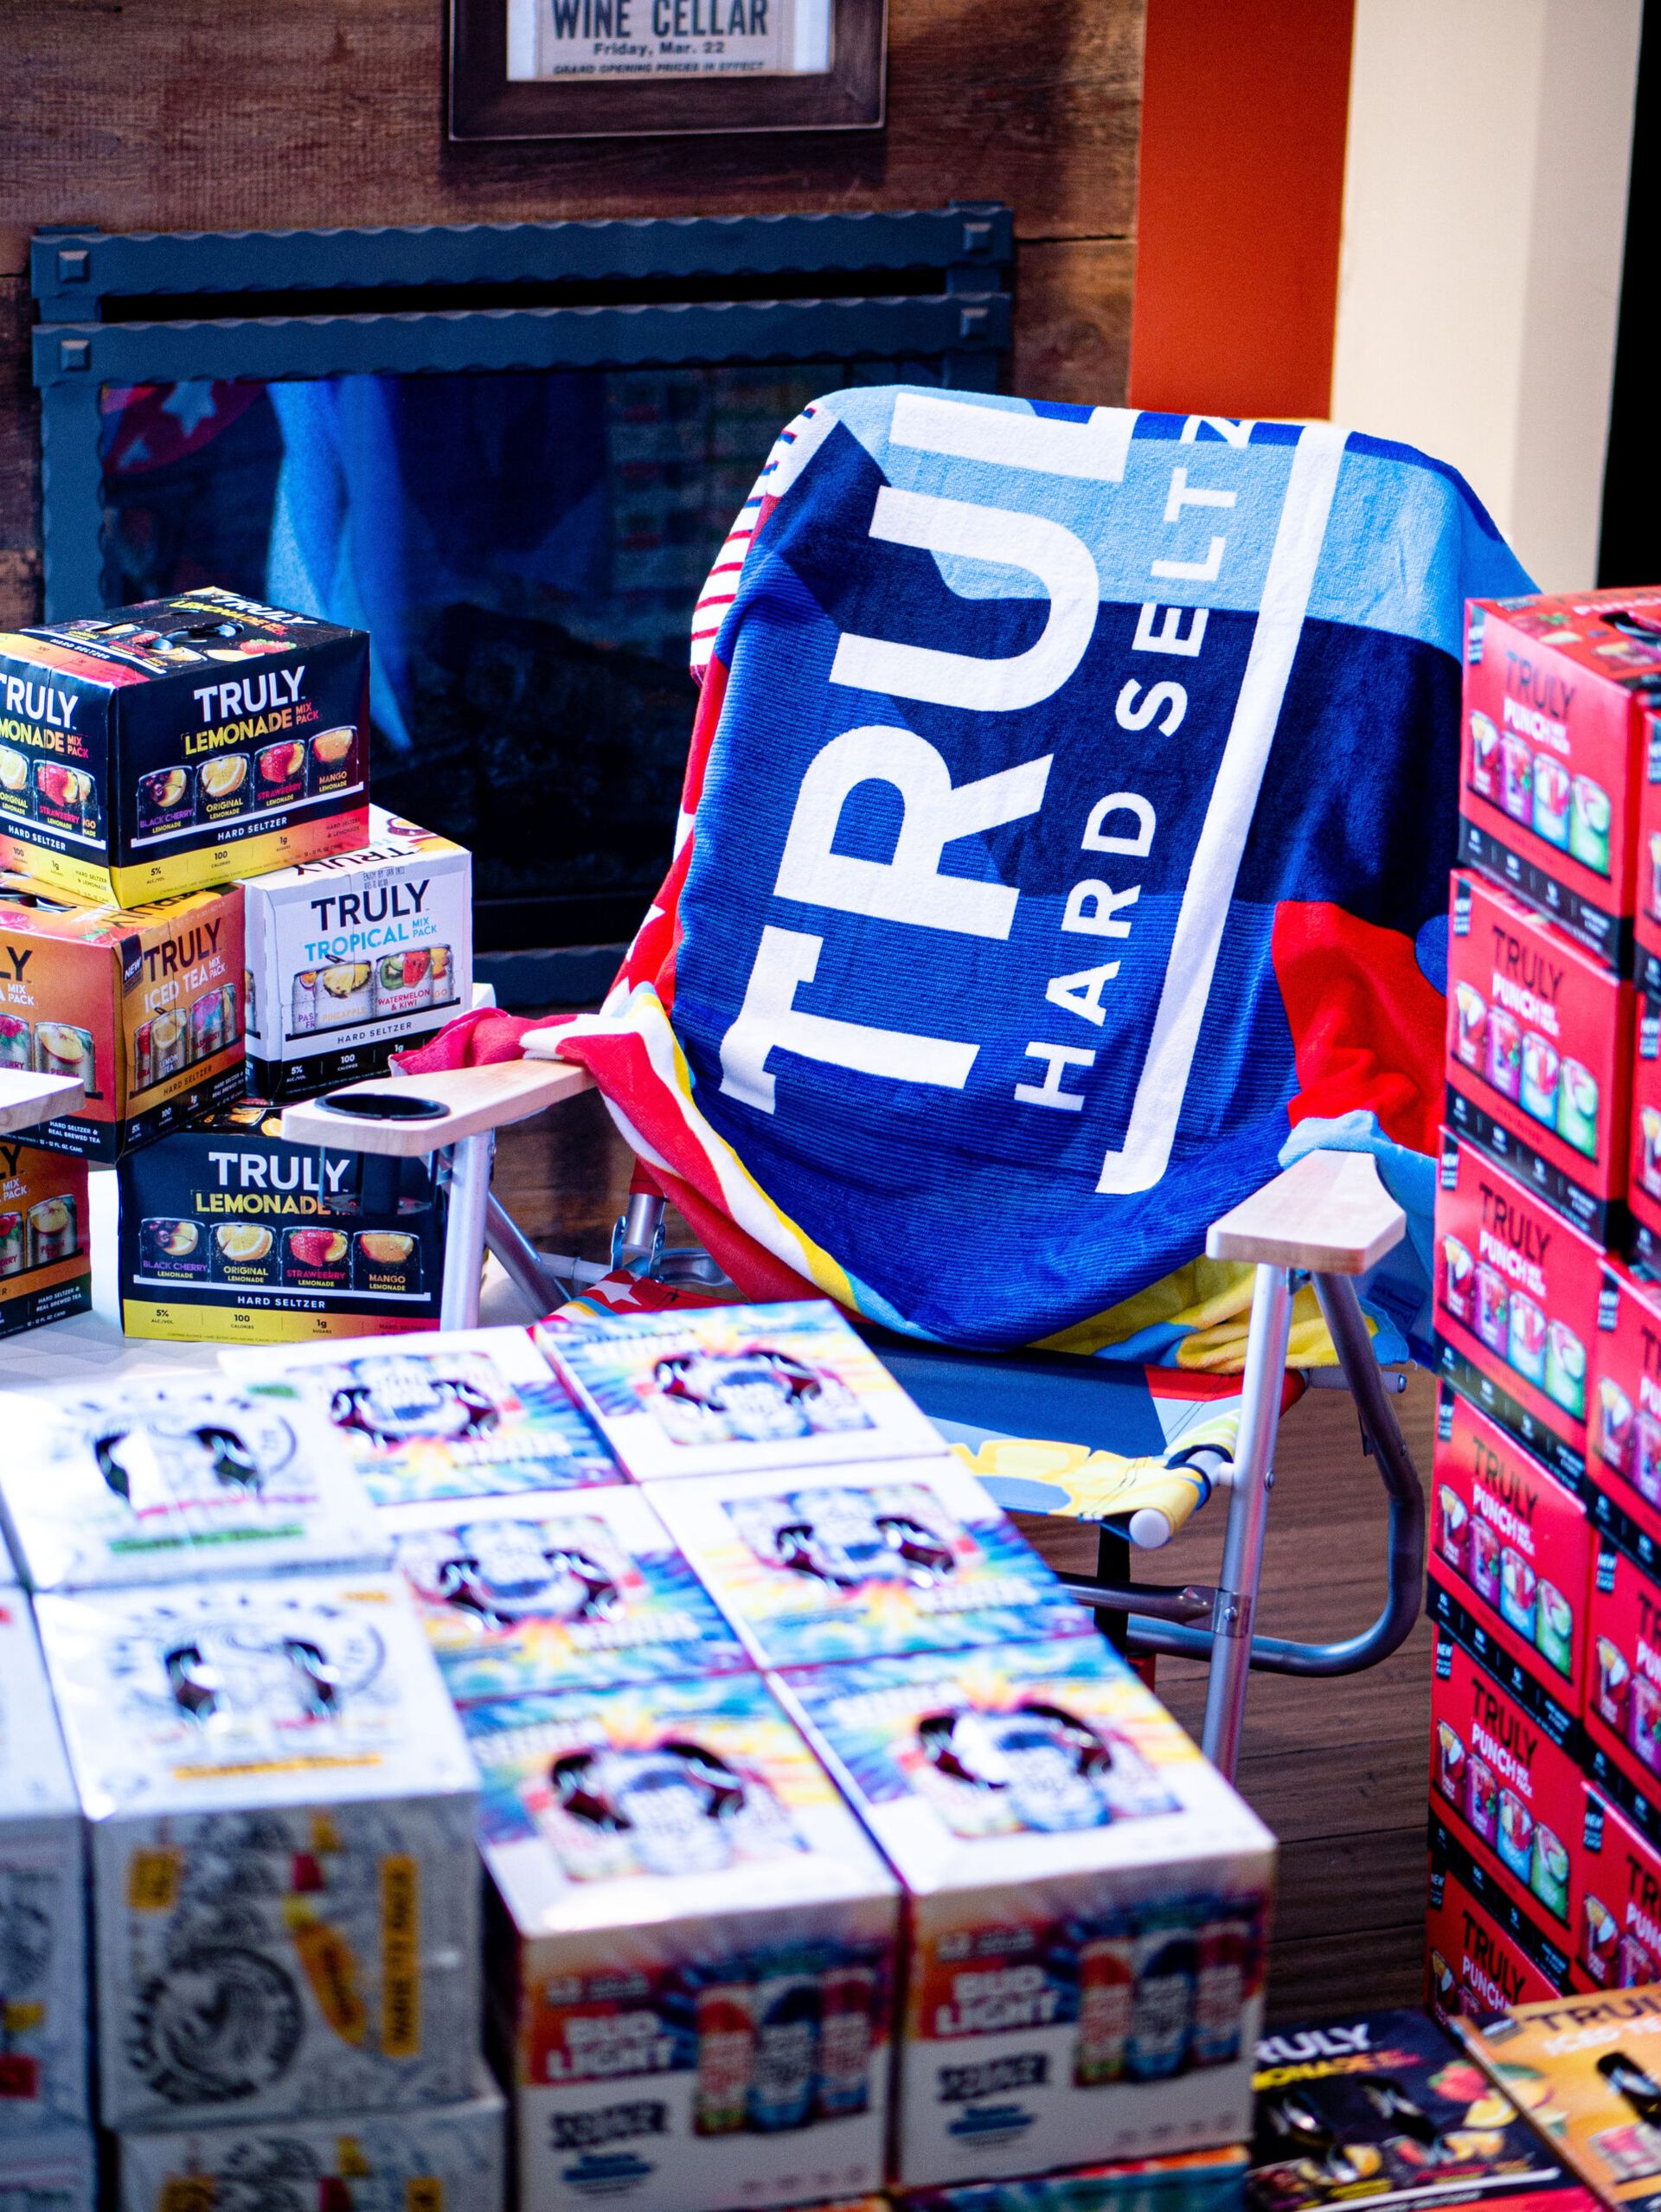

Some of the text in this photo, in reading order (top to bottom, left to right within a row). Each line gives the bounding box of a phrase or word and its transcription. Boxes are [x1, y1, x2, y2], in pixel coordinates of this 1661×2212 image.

[553, 0, 767, 39] WINE CELLAR
[593, 41, 725, 57] Friday, Mar. 22
[211, 596, 318, 625] TRULY
[1505, 650, 1575, 720] TRULY
[194, 665, 305, 723] TRULY
[295, 702, 312, 715] MIX
[296, 710, 319, 725] PACK
[185, 708, 292, 755] LEMONADE
[67, 734, 82, 747] MIX
[67, 745, 89, 759] PACK
[319, 771, 347, 785] MANGO
[319, 780, 347, 792] LEMONADE
[206, 798, 243, 812] ORIGINAL
[266, 794, 294, 806] LEMONADE
[140, 808, 193, 828] BLACK CHERRY
[209, 808, 240, 820] LEMONADE
[152, 821, 181, 833] LEMONADE
[217, 817, 287, 841] HARD SELTZER
[9, 824, 66, 850] HARD SELTZER
[215, 850, 228, 860] 100
[151, 867, 162, 875] 5%
[311, 879, 430, 931] TRULY
[413, 917, 429, 928] MIX
[413, 925, 437, 938] PACK
[144, 918, 221, 982] TRULY
[305, 923, 409, 962] TROPICAL
[1014, 792, 1158, 1112] HARD
[124, 957, 142, 981] NEW
[208, 955, 221, 969] MIX
[1493, 925, 1562, 1000] TRULY
[209, 962, 226, 979] PACK
[7, 984, 26, 994] MIX
[145, 980, 180, 1014] ICED
[183, 965, 208, 993] TEA
[8, 994, 35, 1005] PACK
[378, 989, 431, 1006] WATERMELON
[400, 999, 418, 1010] KIWI
[337, 1022, 413, 1044] HARD SELTZER
[394, 1044, 404, 1053] 1g
[341, 1054, 356, 1064] 100
[291, 1065, 303, 1075] 5%
[163, 1065, 212, 1096] HARD SELTZER
[48, 1128, 62, 1137] REAL
[64, 1132, 87, 1141] BREWED
[49, 1121, 66, 1130] HARD
[67, 1125, 91, 1134] SELTZER
[208, 1152, 350, 1192] TRULY
[3, 1177, 19, 1190] MIX
[3, 1185, 27, 1201] PACK
[1480, 1182, 1550, 1266] TRULY
[143, 1260, 208, 1272] BLACK CHERRY
[223, 1266, 269, 1276] ORIGINAL
[286, 1270, 346, 1280] STRAWBERRY
[369, 1274, 406, 1284] MANGO
[38, 1295, 53, 1304] HARD
[54, 1289, 74, 1299] SELTZER
[238, 1297, 326, 1308] HARD SELTZER
[317, 1319, 327, 1328] 1g
[1472, 1435, 1539, 1523] TRULY
[1472, 1484, 1518, 1544] PUNCH
[1436, 1643, 1453, 1657] NEW
[1472, 1677, 1537, 1768] TRULY
[1472, 1722, 1516, 1781] PUNCH
[1463, 1910, 1525, 2007] TRULY
[955, 1964, 1043, 2000] BUD
[1463, 1955, 1504, 2010] PUNCH
[936, 1990, 1059, 2035] LIGHT
[566, 2011, 659, 2043] BUD
[547, 2036, 676, 2080] LIGHT
